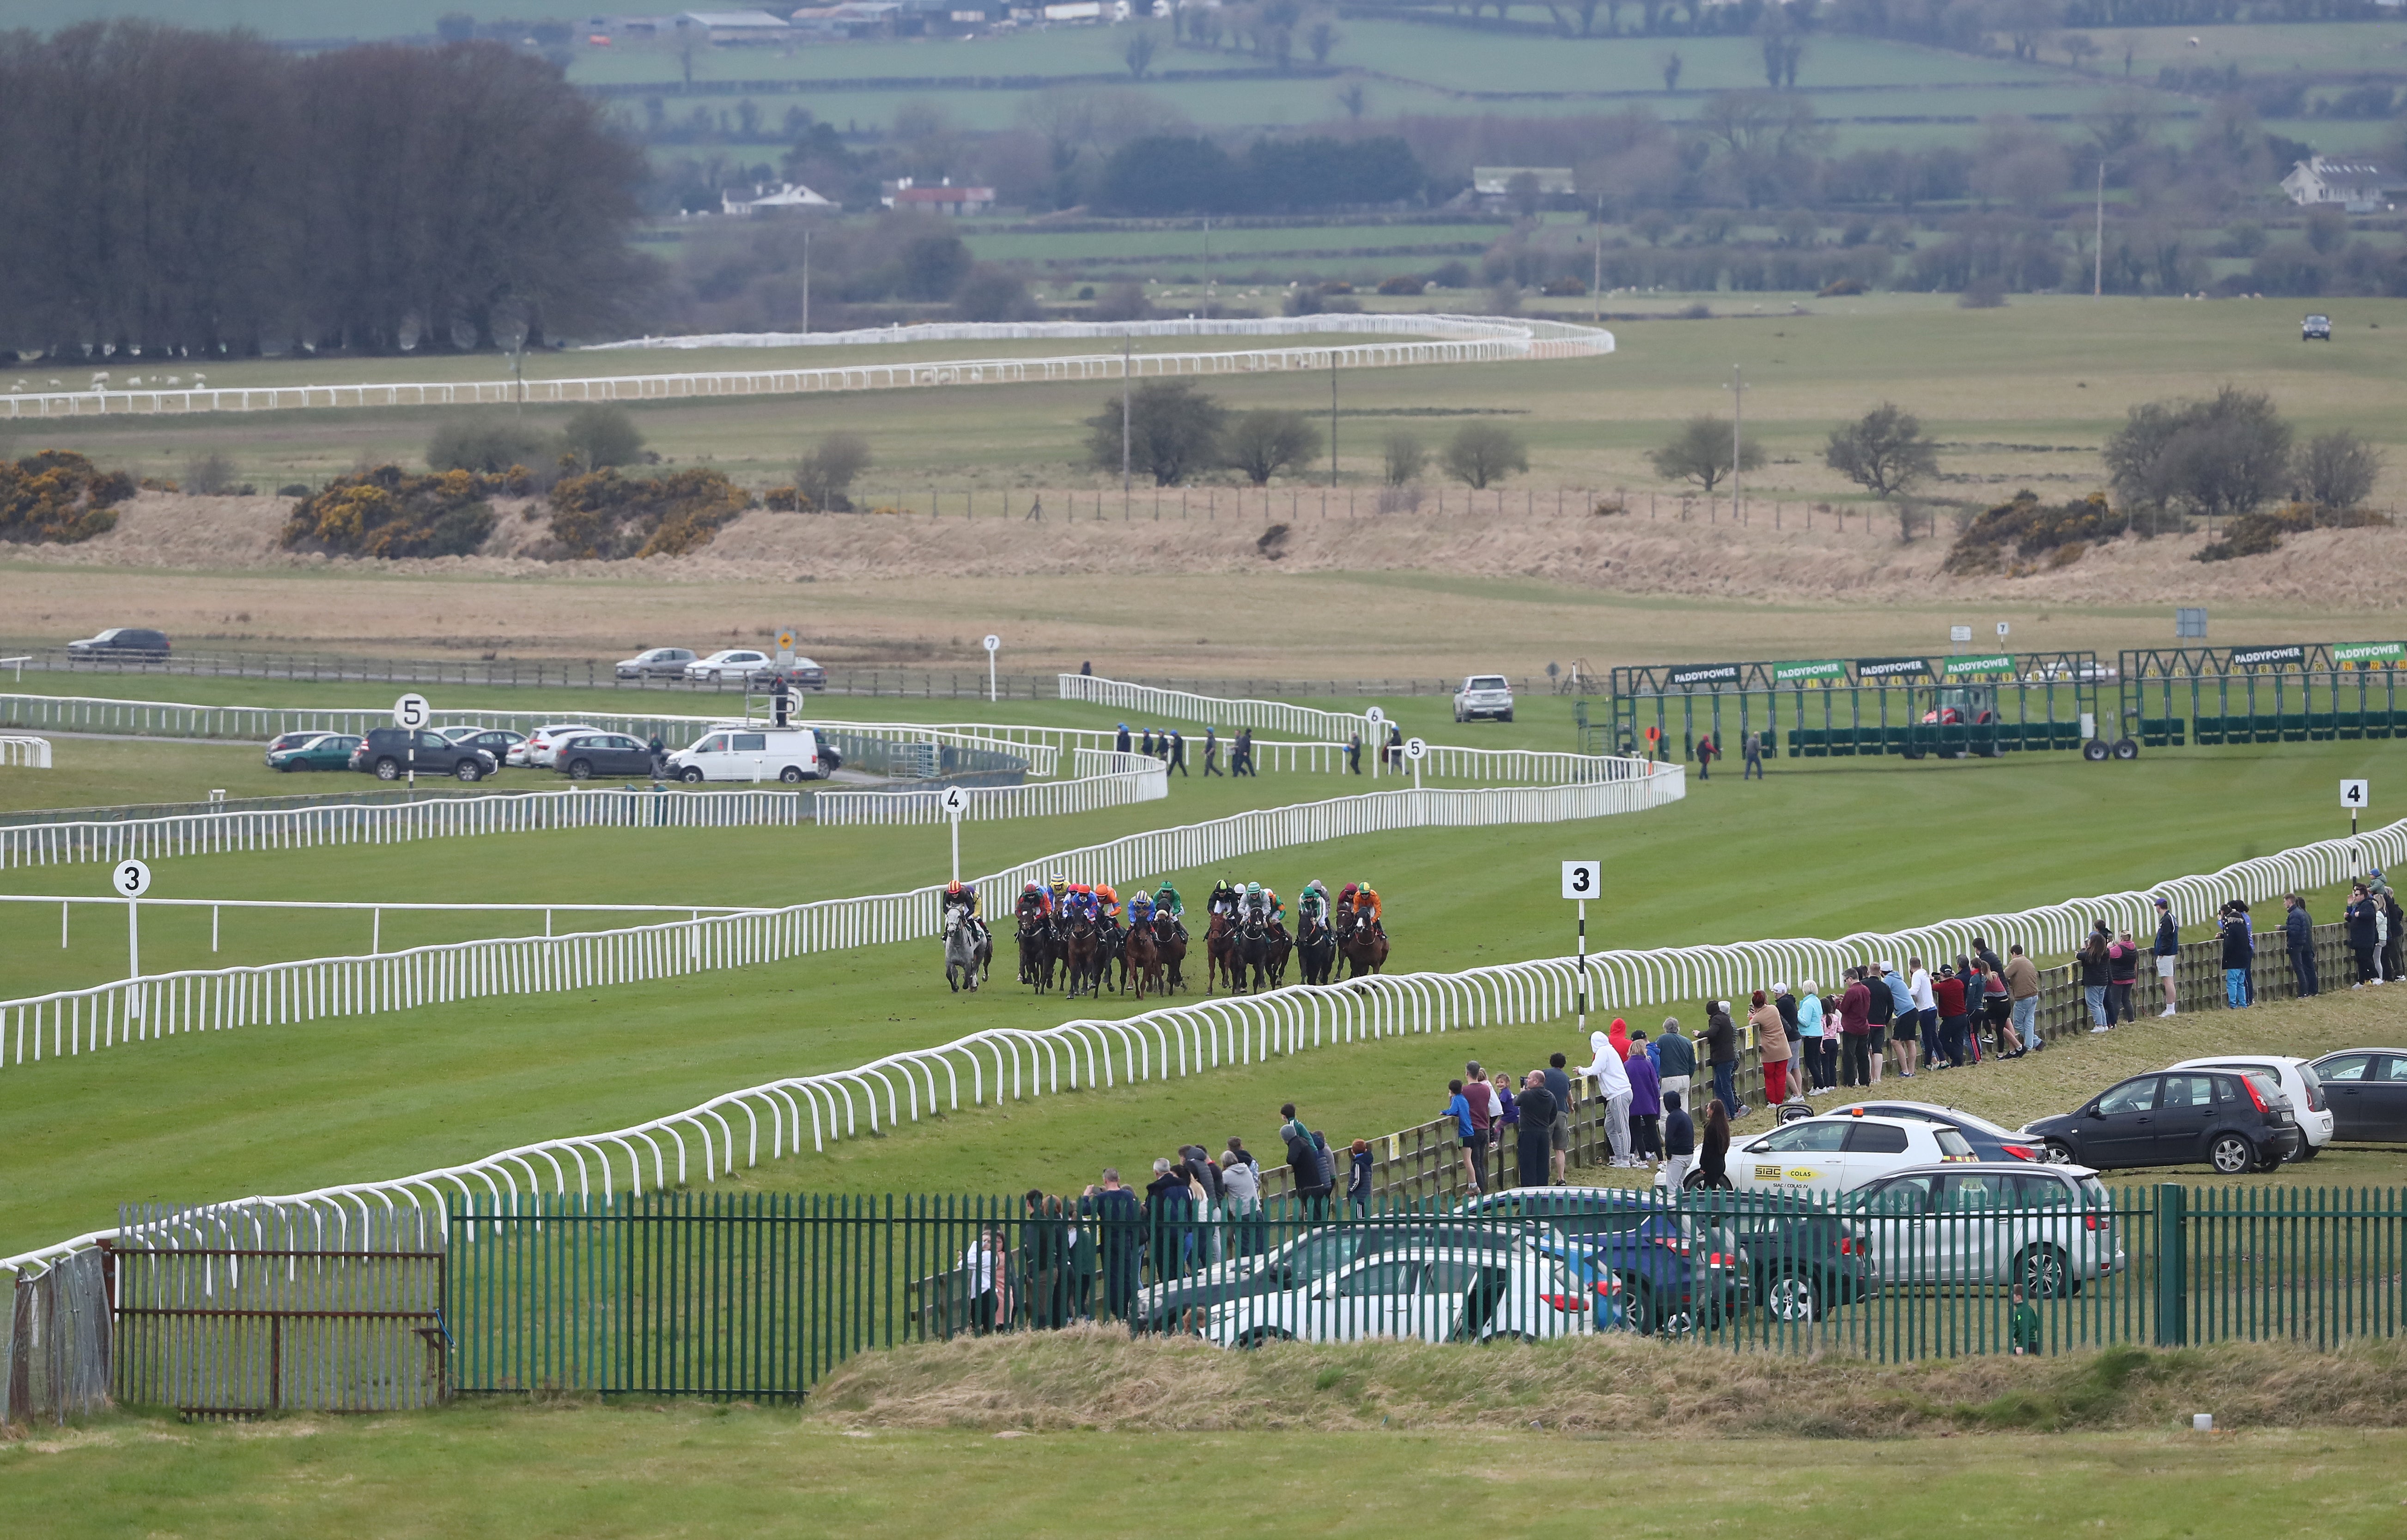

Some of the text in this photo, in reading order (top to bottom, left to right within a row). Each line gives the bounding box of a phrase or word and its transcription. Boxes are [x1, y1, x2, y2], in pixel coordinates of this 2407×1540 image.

[988, 638, 995, 648] 7
[2334, 644, 2400, 660] PADDYPOWER
[1777, 663, 1839, 679] PADDYPOWER
[1860, 661, 1922, 676] PADDYPOWER
[1948, 658, 2009, 673] PADDYPOWER
[1675, 667, 1736, 683] PADDYPOWER
[404, 700, 420, 725] 5
[1372, 710, 1378, 721] 6
[1411, 741, 1420, 755] 5
[948, 790, 959, 807] 4
[2347, 785, 2360, 802] 4
[124, 867, 140, 891] 3
[1573, 867, 1590, 891] 3
